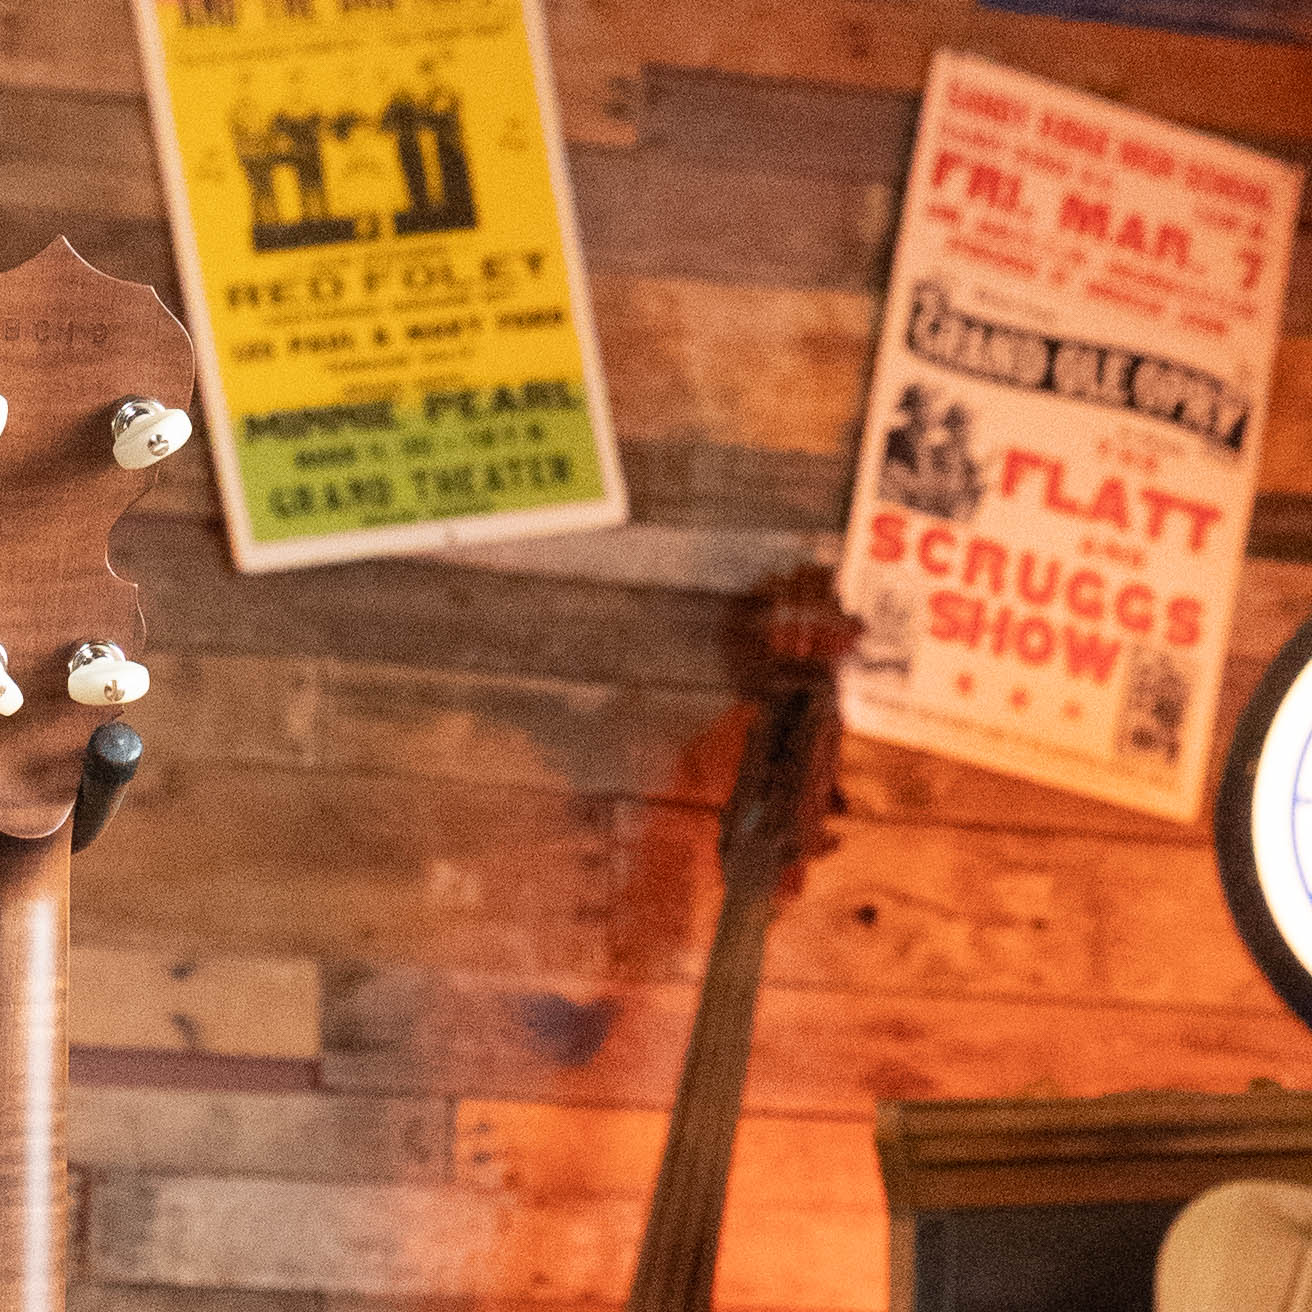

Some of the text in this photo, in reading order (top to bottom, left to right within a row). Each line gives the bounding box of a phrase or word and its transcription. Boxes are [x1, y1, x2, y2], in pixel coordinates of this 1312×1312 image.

[364, 250, 546, 294] FOLEY
[1240, 247, 1263, 290] 7
[424, 382, 576, 421] PEARL
[269, 477, 392, 518] GRAND
[411, 455, 572, 498] THEATER
[1001, 447, 1222, 553] FLATT
[870, 514, 1203, 648] SCRUGGS
[927, 590, 1122, 684] SHOW
